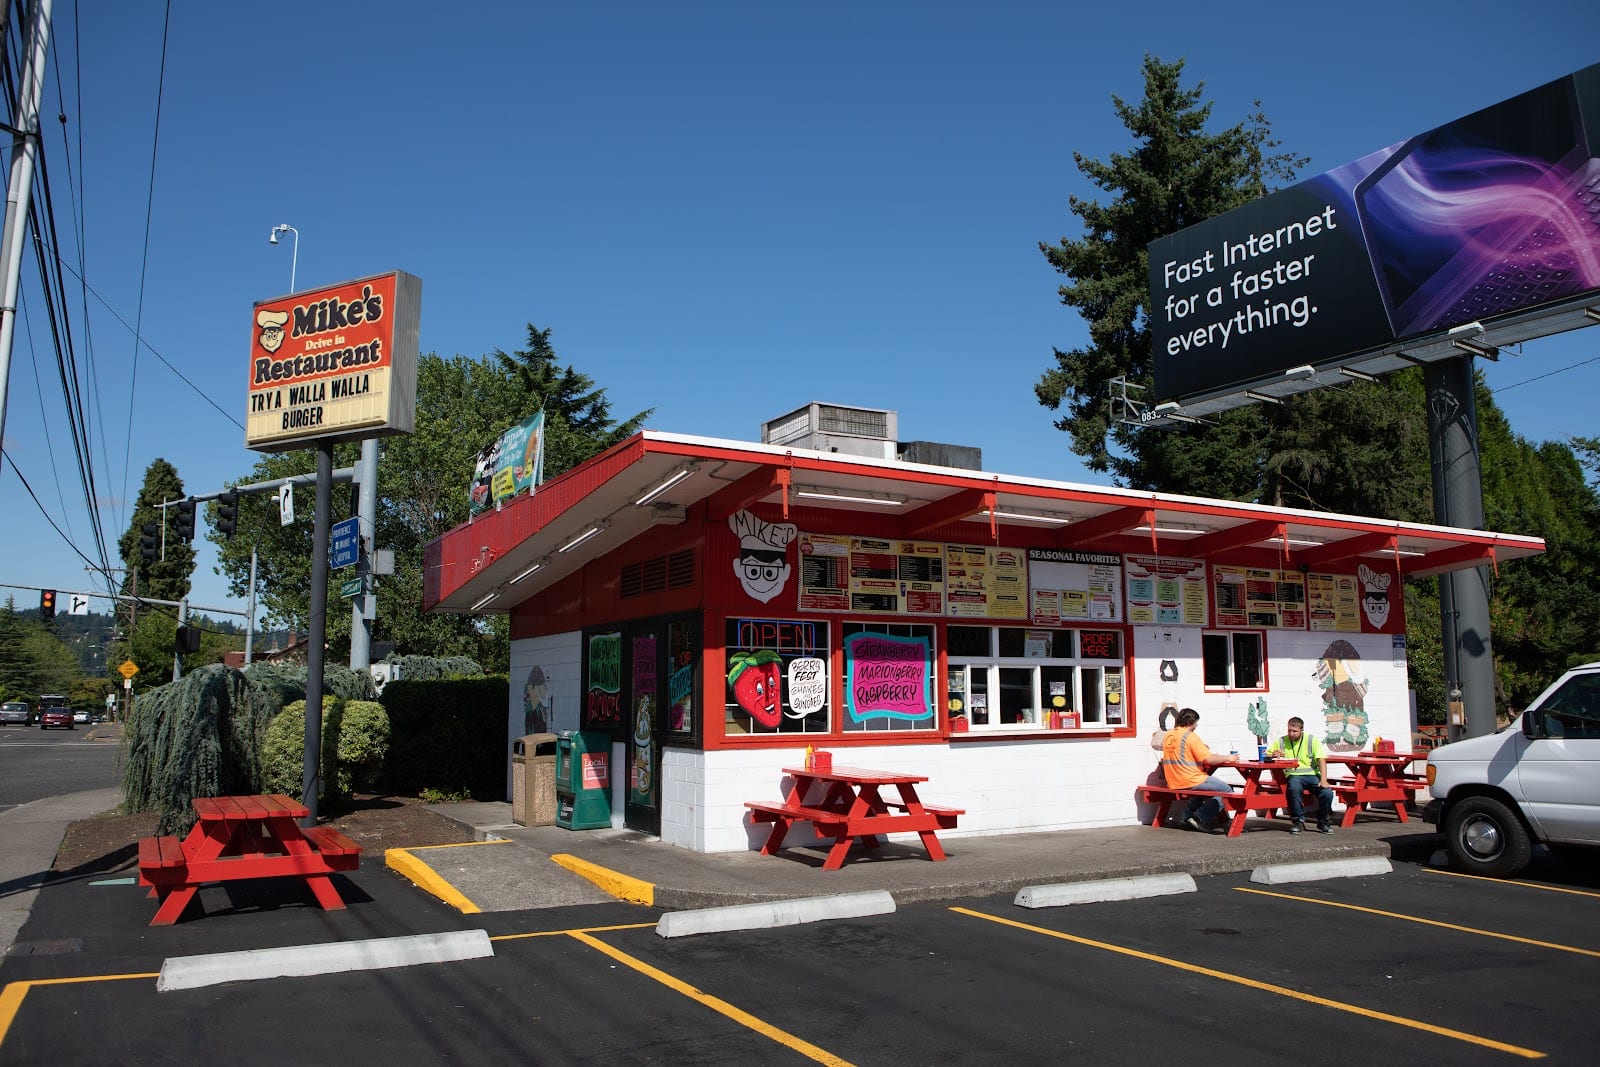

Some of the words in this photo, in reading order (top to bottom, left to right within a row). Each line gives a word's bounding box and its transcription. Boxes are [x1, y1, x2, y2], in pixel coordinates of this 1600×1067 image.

[1164, 250, 1215, 289] Fast
[1223, 205, 1337, 267] Internet
[1165, 295, 1199, 322] for
[1206, 286, 1222, 307] a
[1230, 254, 1315, 299] faster
[292, 285, 382, 338] Mike's
[1167, 295, 1318, 356] everything.
[305, 339, 333, 351] Drive
[334, 335, 345, 345] in
[254, 340, 381, 384] Restaurant
[251, 392, 273, 412] TRY
[289, 382, 325, 404] WALLA
[331, 374, 369, 399] WALLA
[282, 406, 323, 430] BURGER
[734, 510, 794, 545] MIKE'S
[1029, 550, 1075, 562] SEASONAL
[1075, 553, 1121, 565] FAVORITES
[740, 623, 812, 653] OPEN
[855, 641, 920, 659] STRAWBERRY
[1081, 645, 1110, 657] HERE
[791, 660, 821, 672] BERRY
[795, 671, 819, 682] FEST
[858, 664, 922, 682] MARIONBERRY
[791, 684, 824, 696] SHAKES
[856, 684, 918, 705] RASPBERRY
[584, 757, 606, 767] Local
